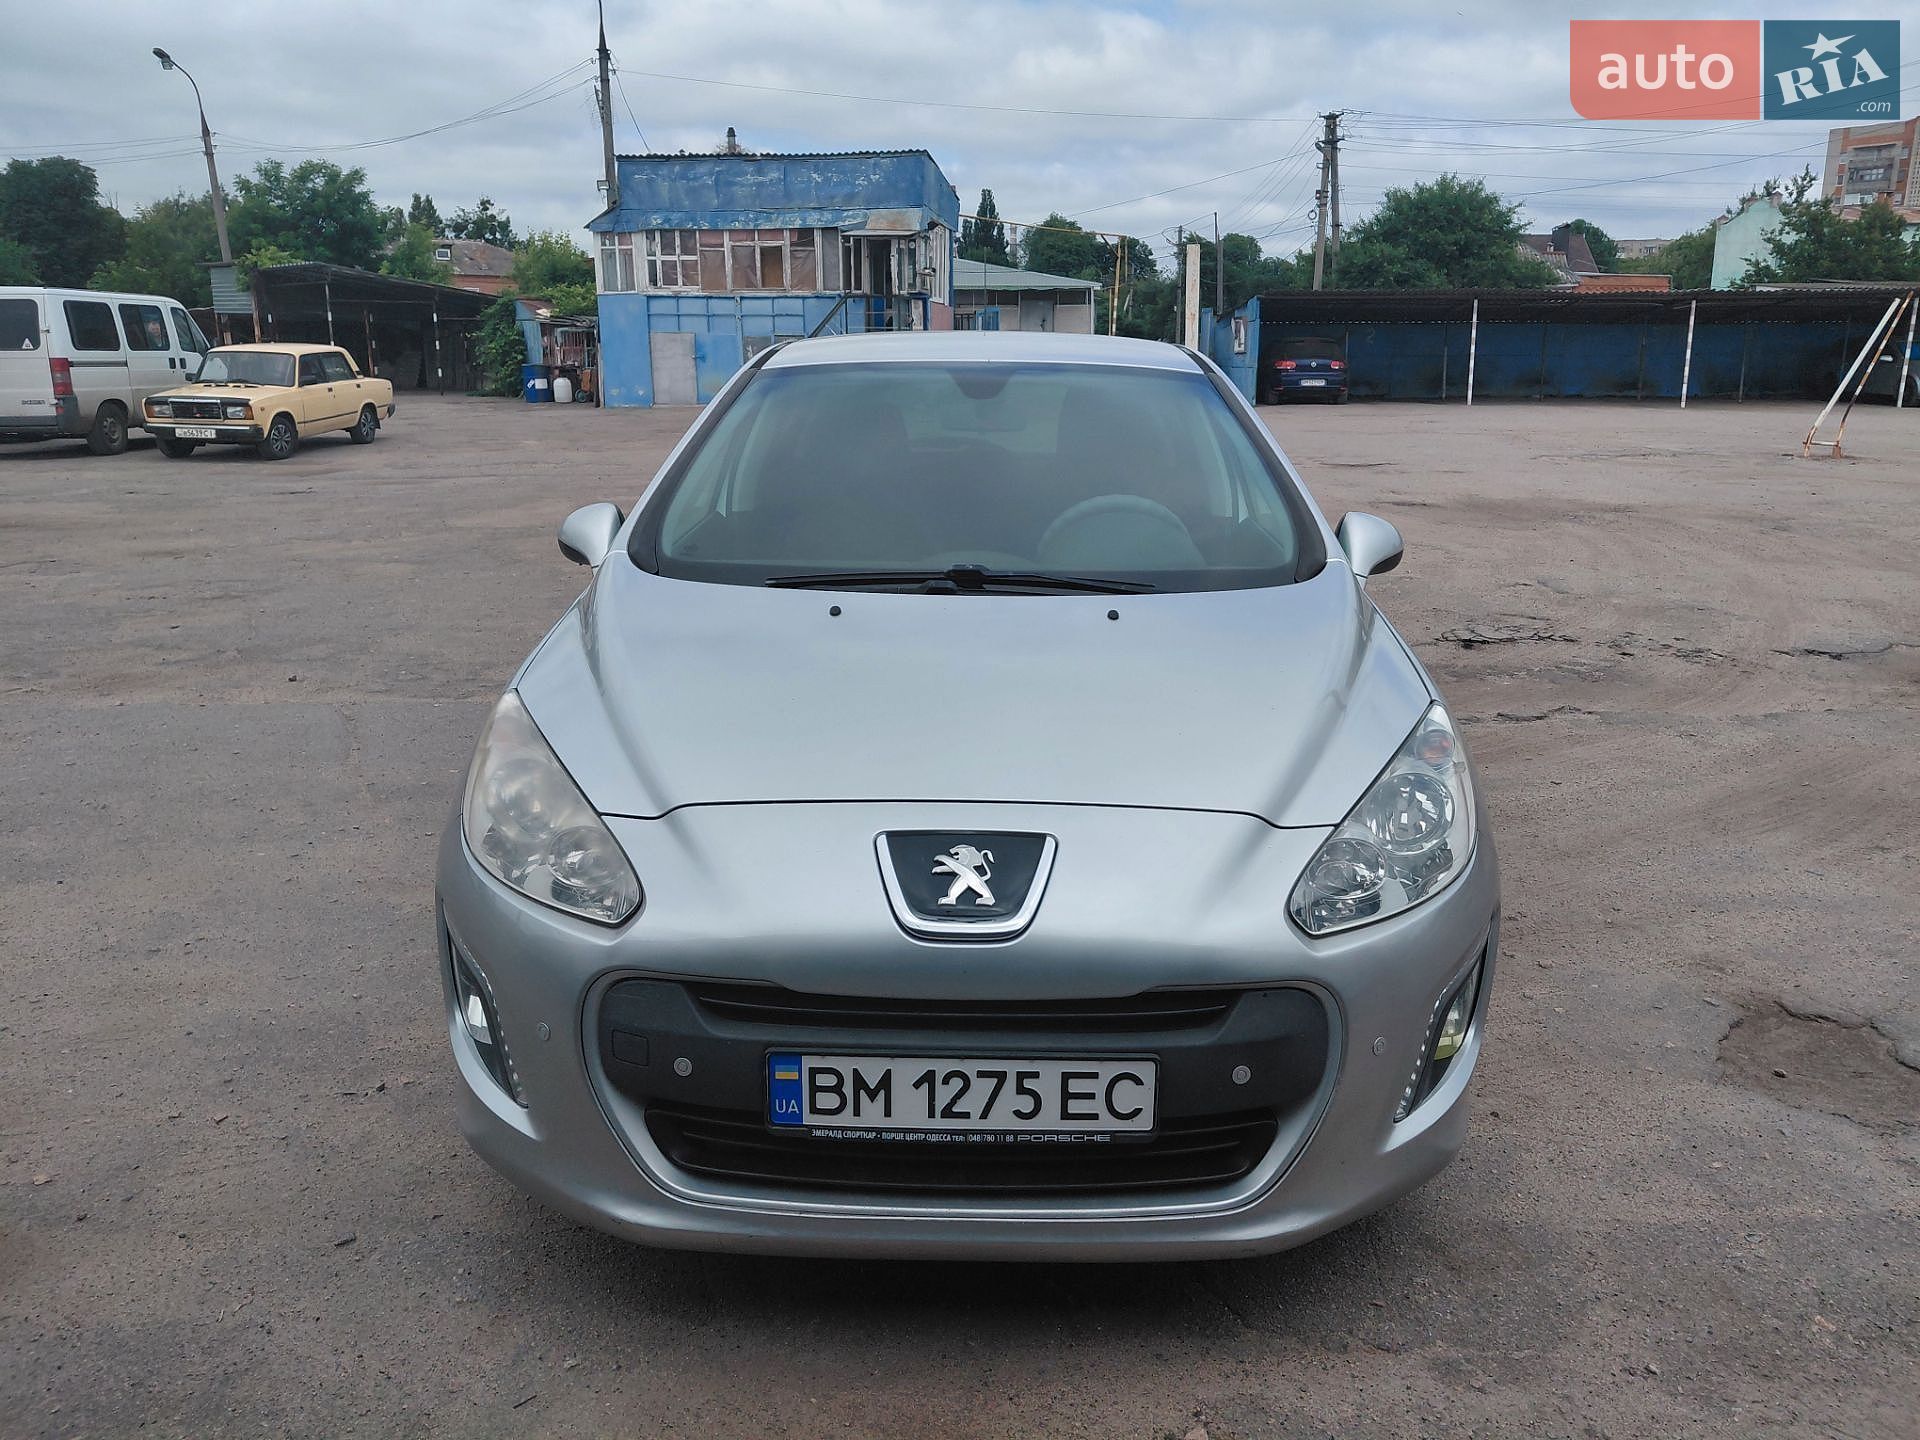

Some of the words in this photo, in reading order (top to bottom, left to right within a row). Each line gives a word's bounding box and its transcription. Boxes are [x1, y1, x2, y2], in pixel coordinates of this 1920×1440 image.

[808, 1066, 892, 1118] BM
[912, 1069, 1042, 1120] 1275
[1060, 1071, 1145, 1121] EC
[775, 1099, 799, 1114] UA
[882, 1131, 904, 1140] ПОРШЕ
[906, 1132, 925, 1141] ЦЕНТР
[926, 1133, 950, 1142] ОДЕССА
[997, 1134, 1004, 1142] 11
[1017, 1134, 1111, 1142] PORSCHE
